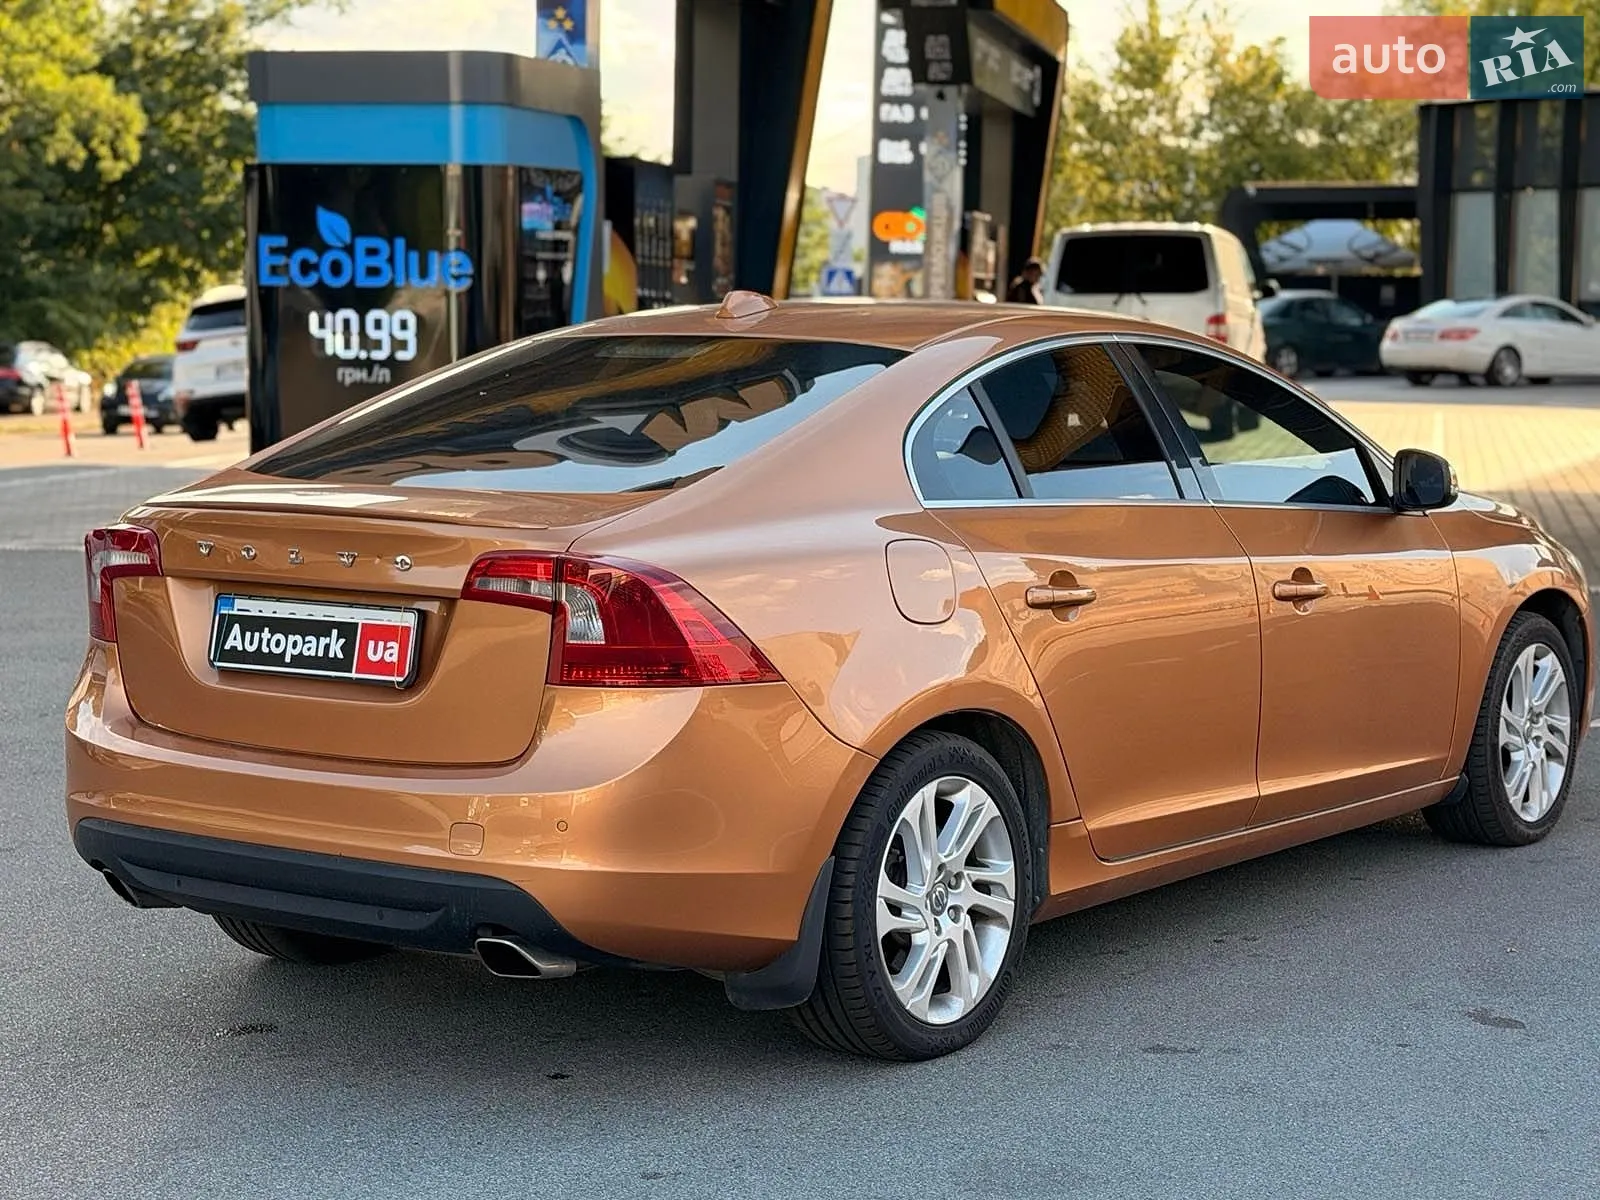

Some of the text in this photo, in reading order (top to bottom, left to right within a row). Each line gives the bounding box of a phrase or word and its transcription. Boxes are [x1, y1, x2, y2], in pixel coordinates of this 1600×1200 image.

[257, 234, 475, 291] EcoBlue
[308, 308, 418, 361] 40.99
[196, 540, 413, 572] VOLVO
[223, 622, 400, 664] Autopark ua
